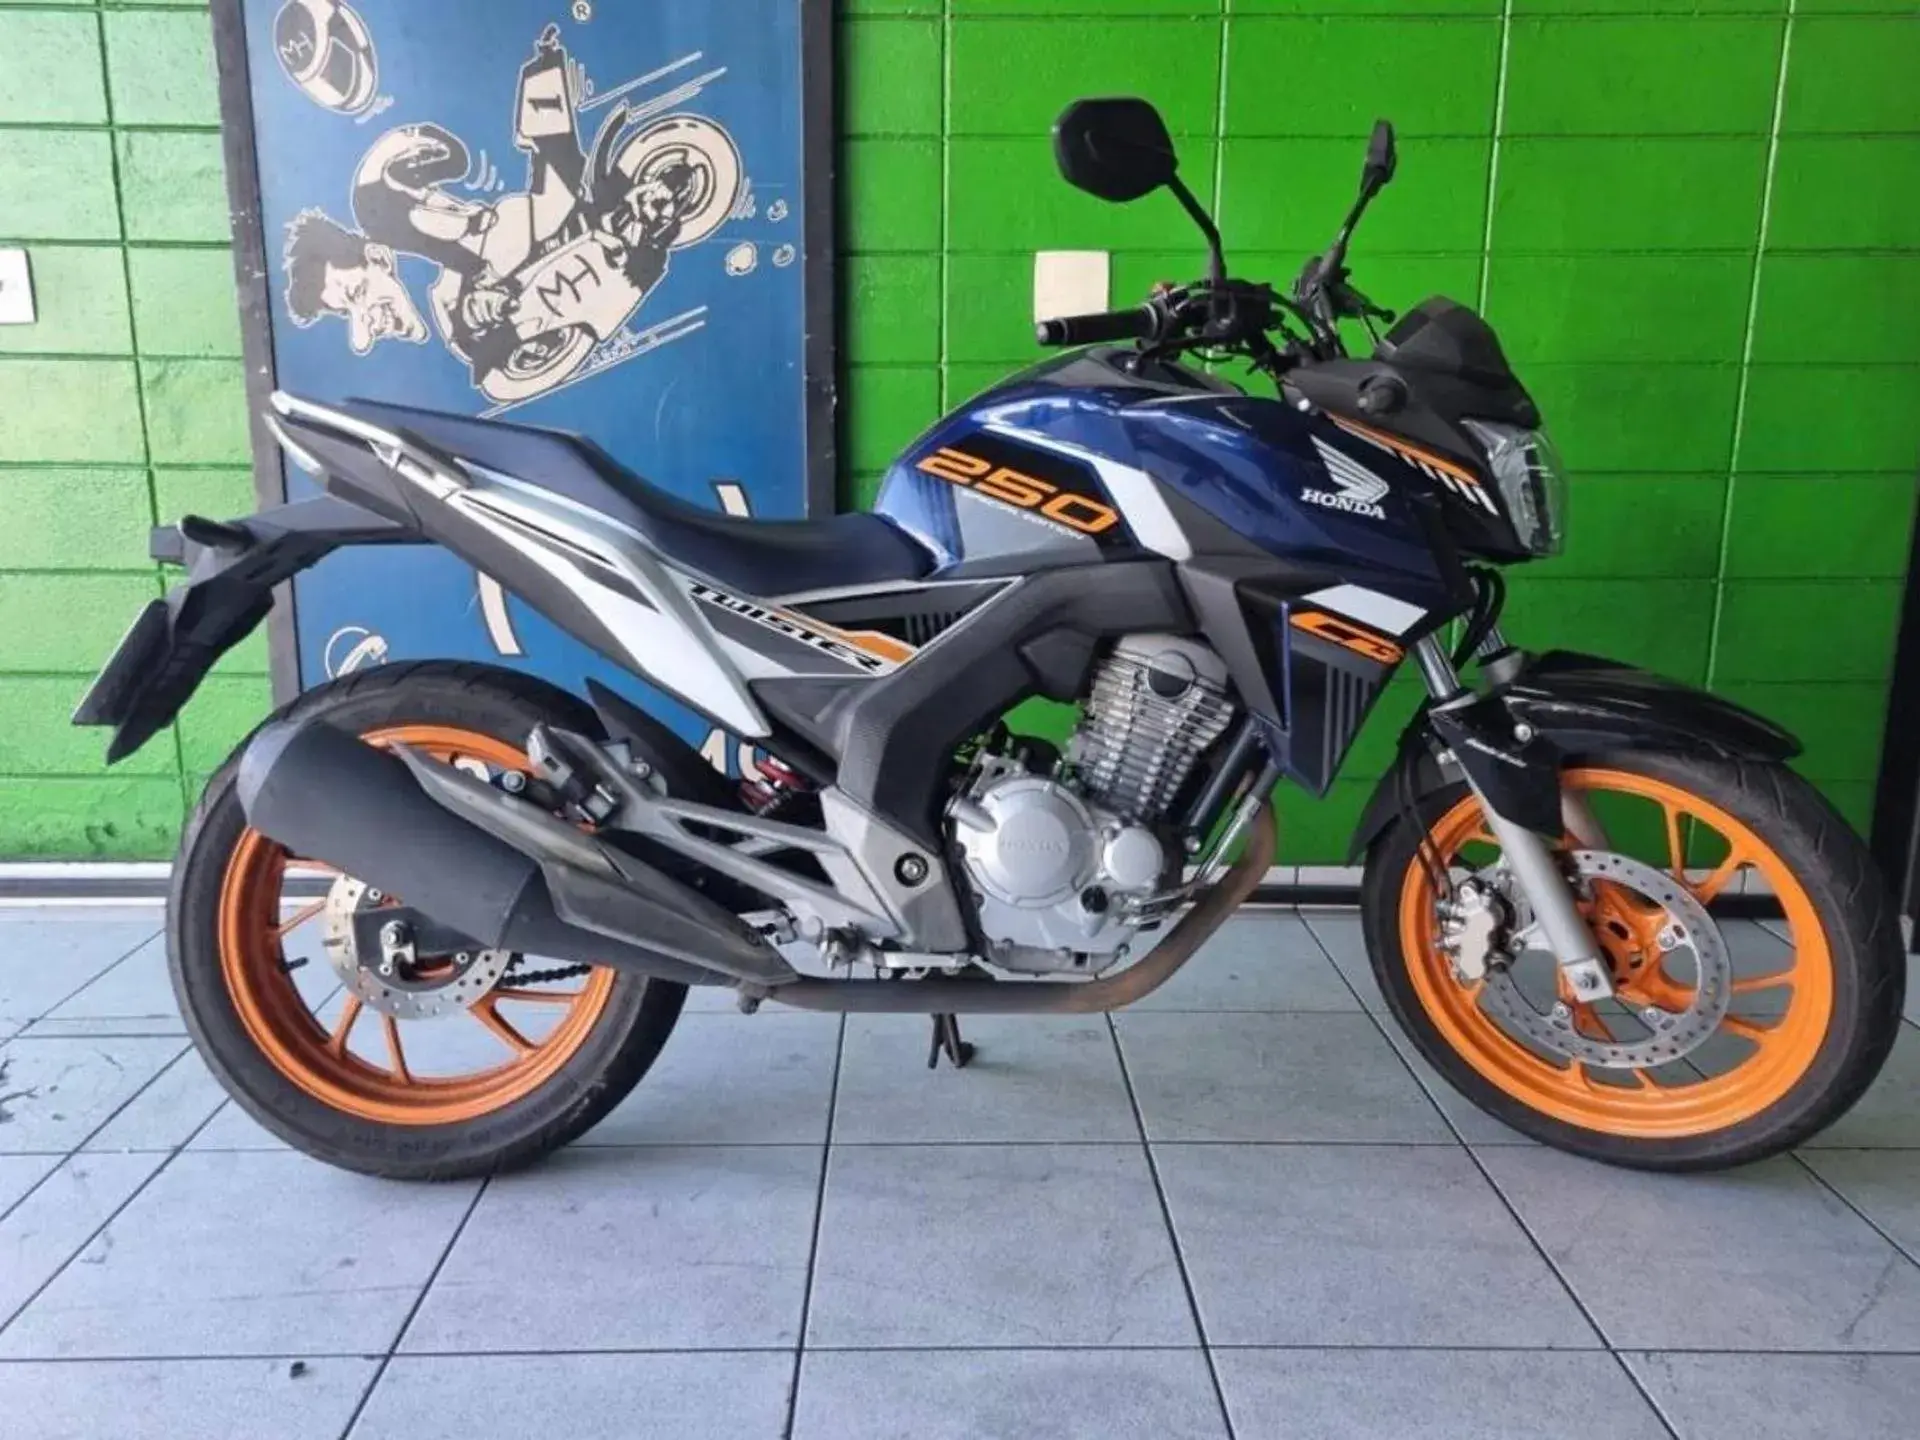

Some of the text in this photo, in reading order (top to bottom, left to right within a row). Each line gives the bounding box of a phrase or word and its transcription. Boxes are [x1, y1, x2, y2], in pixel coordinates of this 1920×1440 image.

[280, 31, 314, 66] MH
[536, 253, 602, 318] MH
[915, 446, 1120, 534] 250
[1300, 487, 1387, 520] HONDA
[688, 578, 884, 671] TWISTER
[1289, 611, 1405, 665] CB
